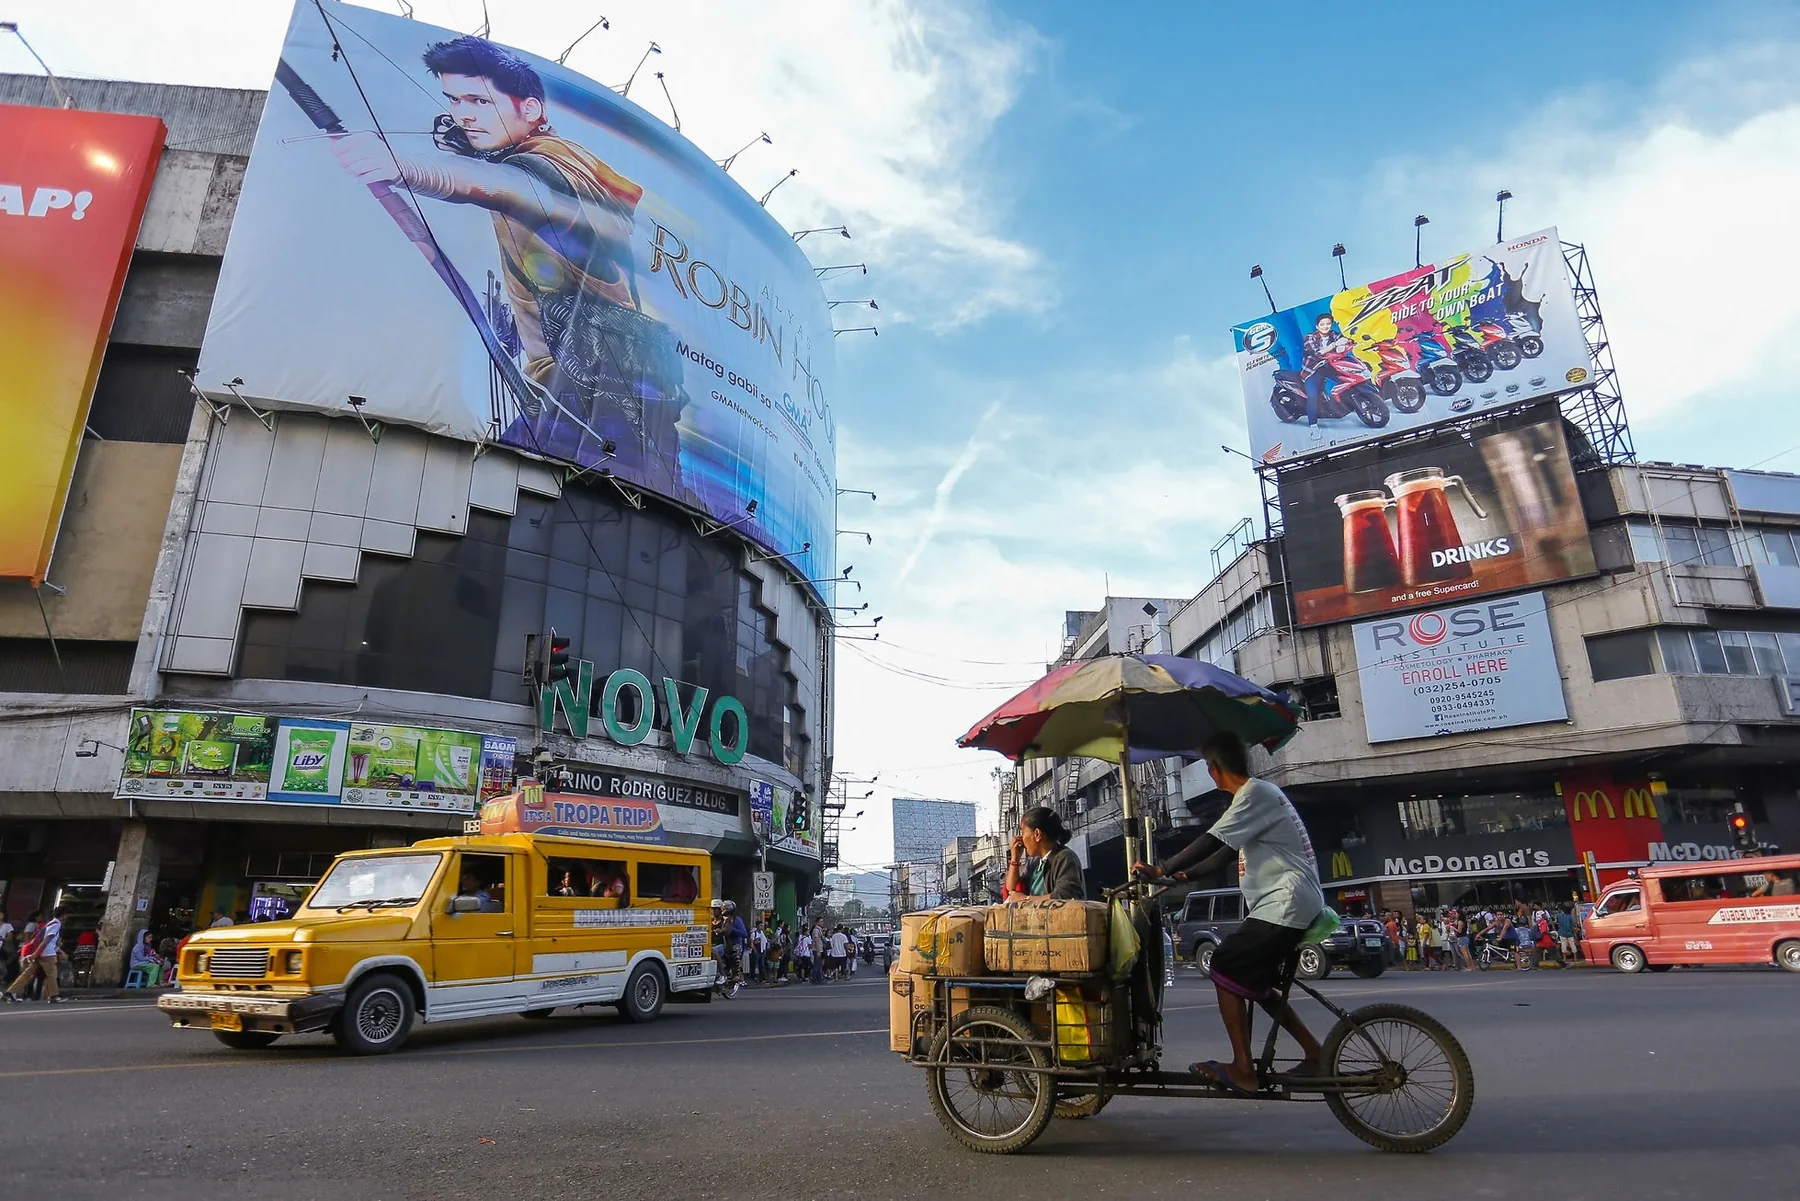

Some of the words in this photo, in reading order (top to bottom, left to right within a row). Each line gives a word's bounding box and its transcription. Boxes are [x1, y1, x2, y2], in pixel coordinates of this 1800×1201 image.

[1507, 235, 1548, 251] HONDA
[647, 215, 783, 369] ROBIN
[1391, 305, 1417, 324] RIDE
[1419, 298, 1434, 312] TO
[1438, 283, 1470, 304] YOUR
[1436, 302, 1465, 321] OWN
[1469, 282, 1504, 308] BeAT
[676, 340, 724, 378] Matag
[728, 371, 758, 397] gabii
[760, 392, 772, 410] sa
[711, 390, 779, 444] GMANetwork.com
[1431, 537, 1510, 569] DRINKS
[1391, 593, 1407, 604] and
[1408, 592, 1414, 600] a
[1415, 588, 1432, 599] free
[1433, 579, 1480, 597] Supercard!
[1372, 601, 1526, 652] ROSE
[1380, 634, 1526, 665] INSTITUTE
[1394, 657, 1454, 672] COSMETOLOGY
[1468, 648, 1514, 661] PHARMACY
[1466, 657, 1509, 676] HERE
[1413, 676, 1501, 697] (032)254-0705
[1430, 689, 1495, 704] 0920-9545245
[540, 655, 748, 766] NOVO
[1431, 698, 1496, 713] 0933-0494337
[521, 784, 545, 805] TNT
[610, 777, 692, 804] RODRIGUEZ
[524, 809, 544, 823] IT'S
[545, 812, 552, 822] A
[553, 802, 611, 825] TROPA
[613, 806, 653, 827] TRIP!
[1384, 847, 1551, 876] McDonald's
[1720, 908, 1766, 922] GUADALUPE
